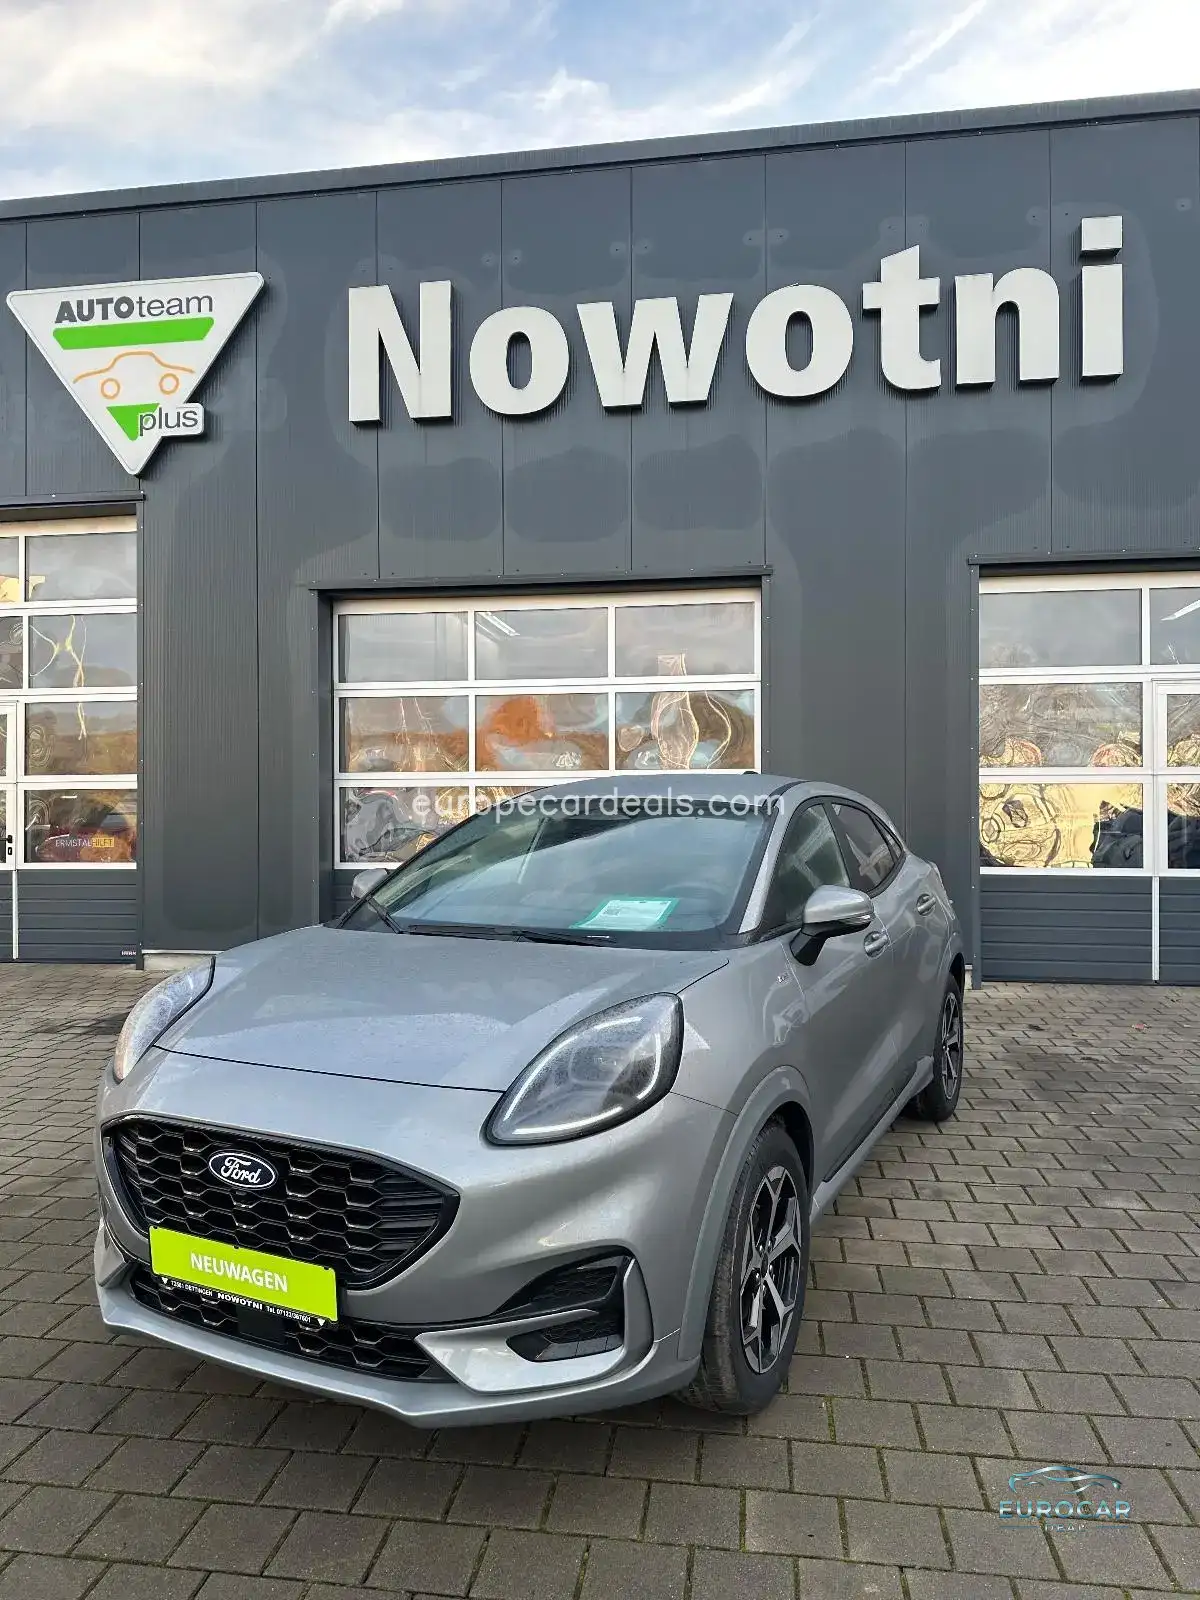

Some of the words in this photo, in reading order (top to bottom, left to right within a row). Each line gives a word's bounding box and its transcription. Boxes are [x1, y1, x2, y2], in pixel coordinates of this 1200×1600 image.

[55, 294, 213, 324] AUTOteam
[348, 215, 1124, 425] Nowotni
[139, 407, 198, 436] plus
[220, 1156, 262, 1184] Ford
[190, 1252, 288, 1292] NEUWAGEN
[217, 1292, 263, 1309] NOWOTNI
